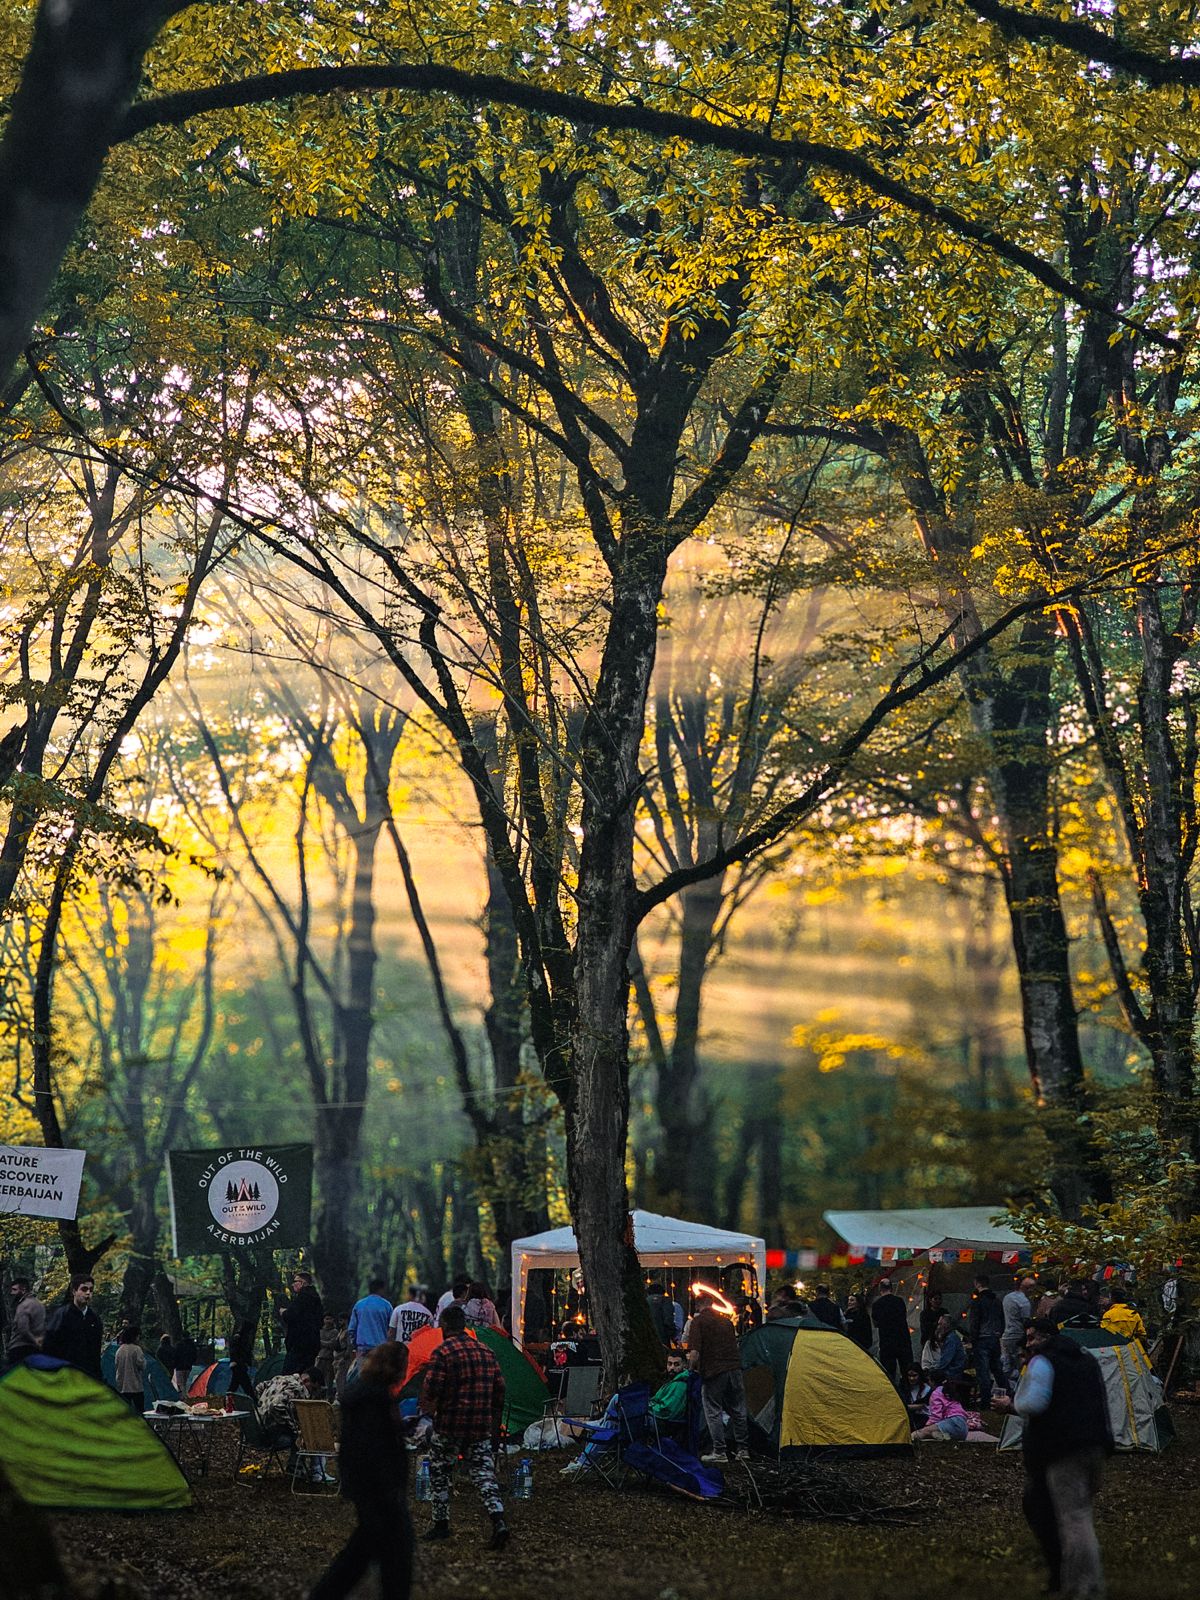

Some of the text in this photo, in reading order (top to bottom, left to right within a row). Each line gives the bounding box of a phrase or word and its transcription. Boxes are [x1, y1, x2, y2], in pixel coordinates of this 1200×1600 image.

[198, 1149, 288, 1188] OUT OF THE WILD
[0, 1184, 63, 1201] ERBAIJAN
[245, 1204, 266, 1212] WILD
[207, 1219, 280, 1245] AZERBAIJAN
